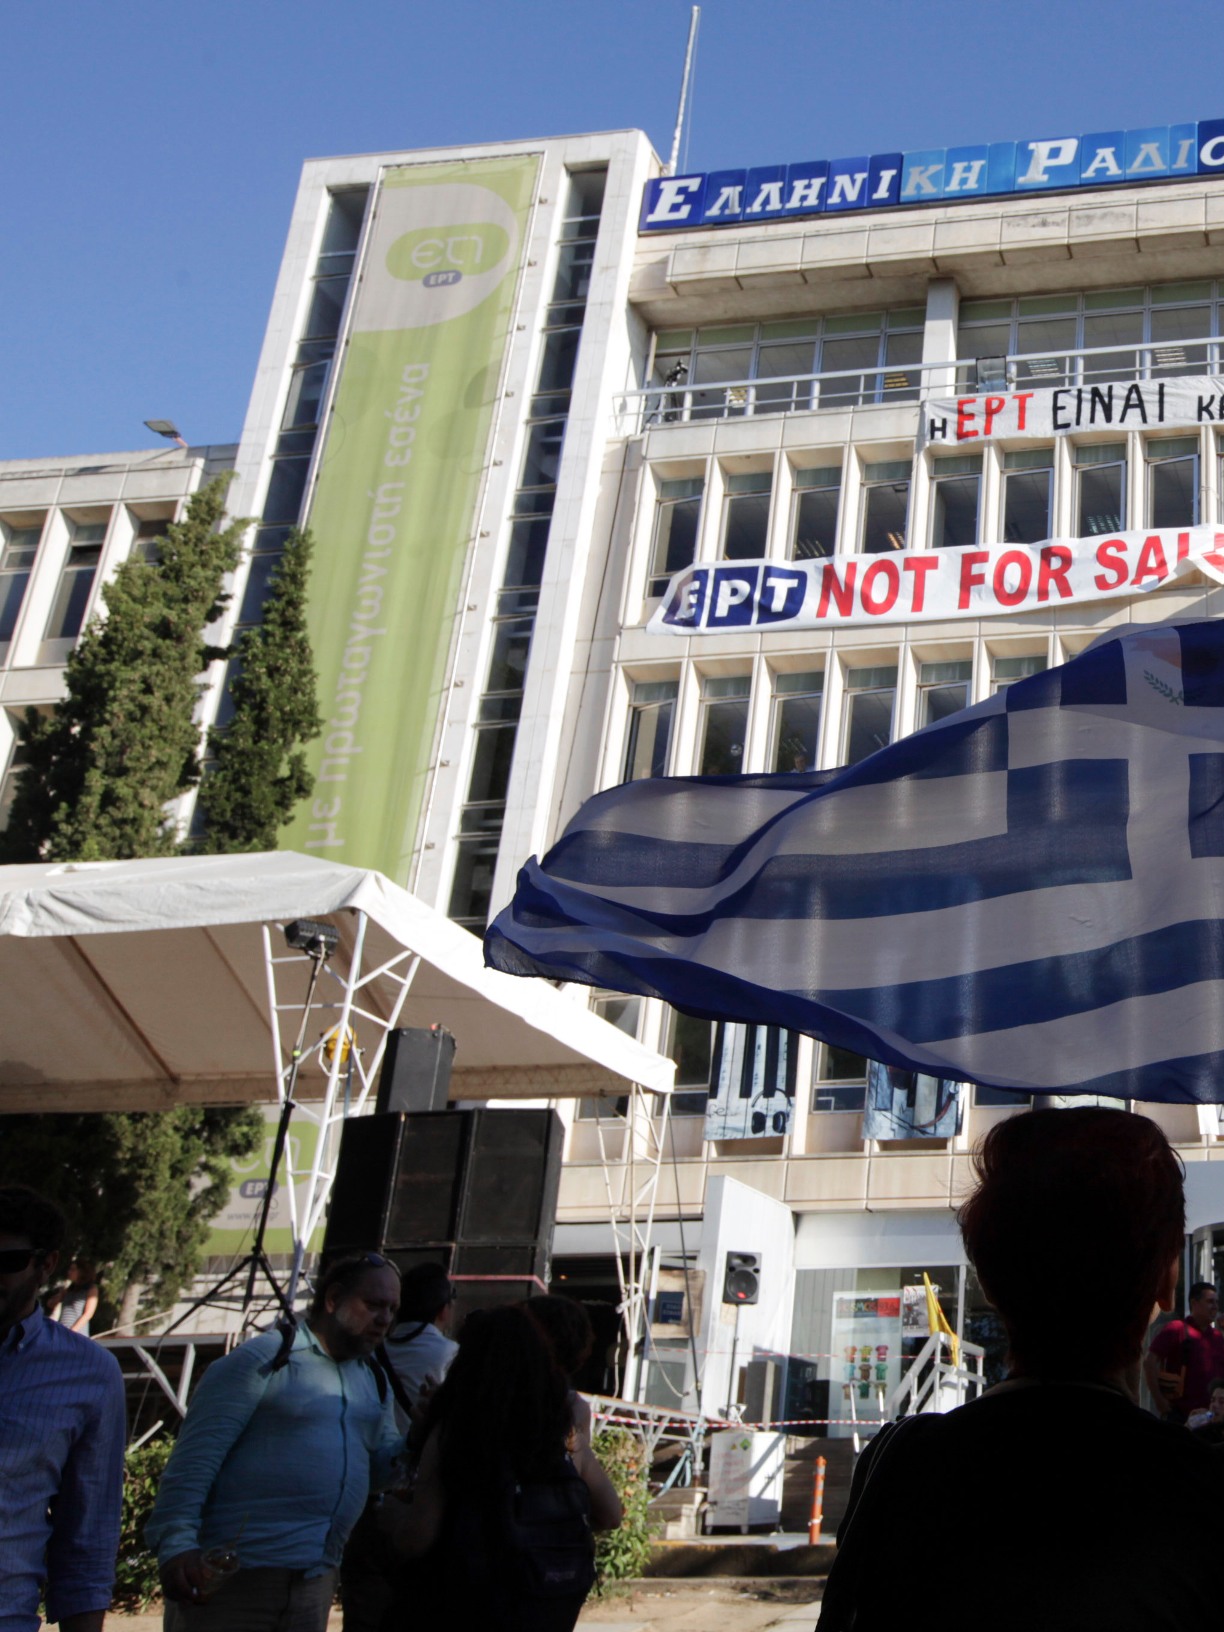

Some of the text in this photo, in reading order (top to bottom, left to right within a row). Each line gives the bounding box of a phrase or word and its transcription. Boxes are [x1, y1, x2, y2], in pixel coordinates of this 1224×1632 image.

[645, 159, 986, 223] ΕΛΛΗΝΙΚΗ
[429, 272, 457, 286] ΕΡΤ
[384, 361, 430, 468] εσένα
[956, 392, 1035, 441] ΕΡΤ
[1051, 382, 1166, 432] ΕΙΝΑΙ
[815, 555, 940, 619] NOT
[958, 545, 1074, 610] FOR
[244, 1181, 271, 1196] ΕΡ
